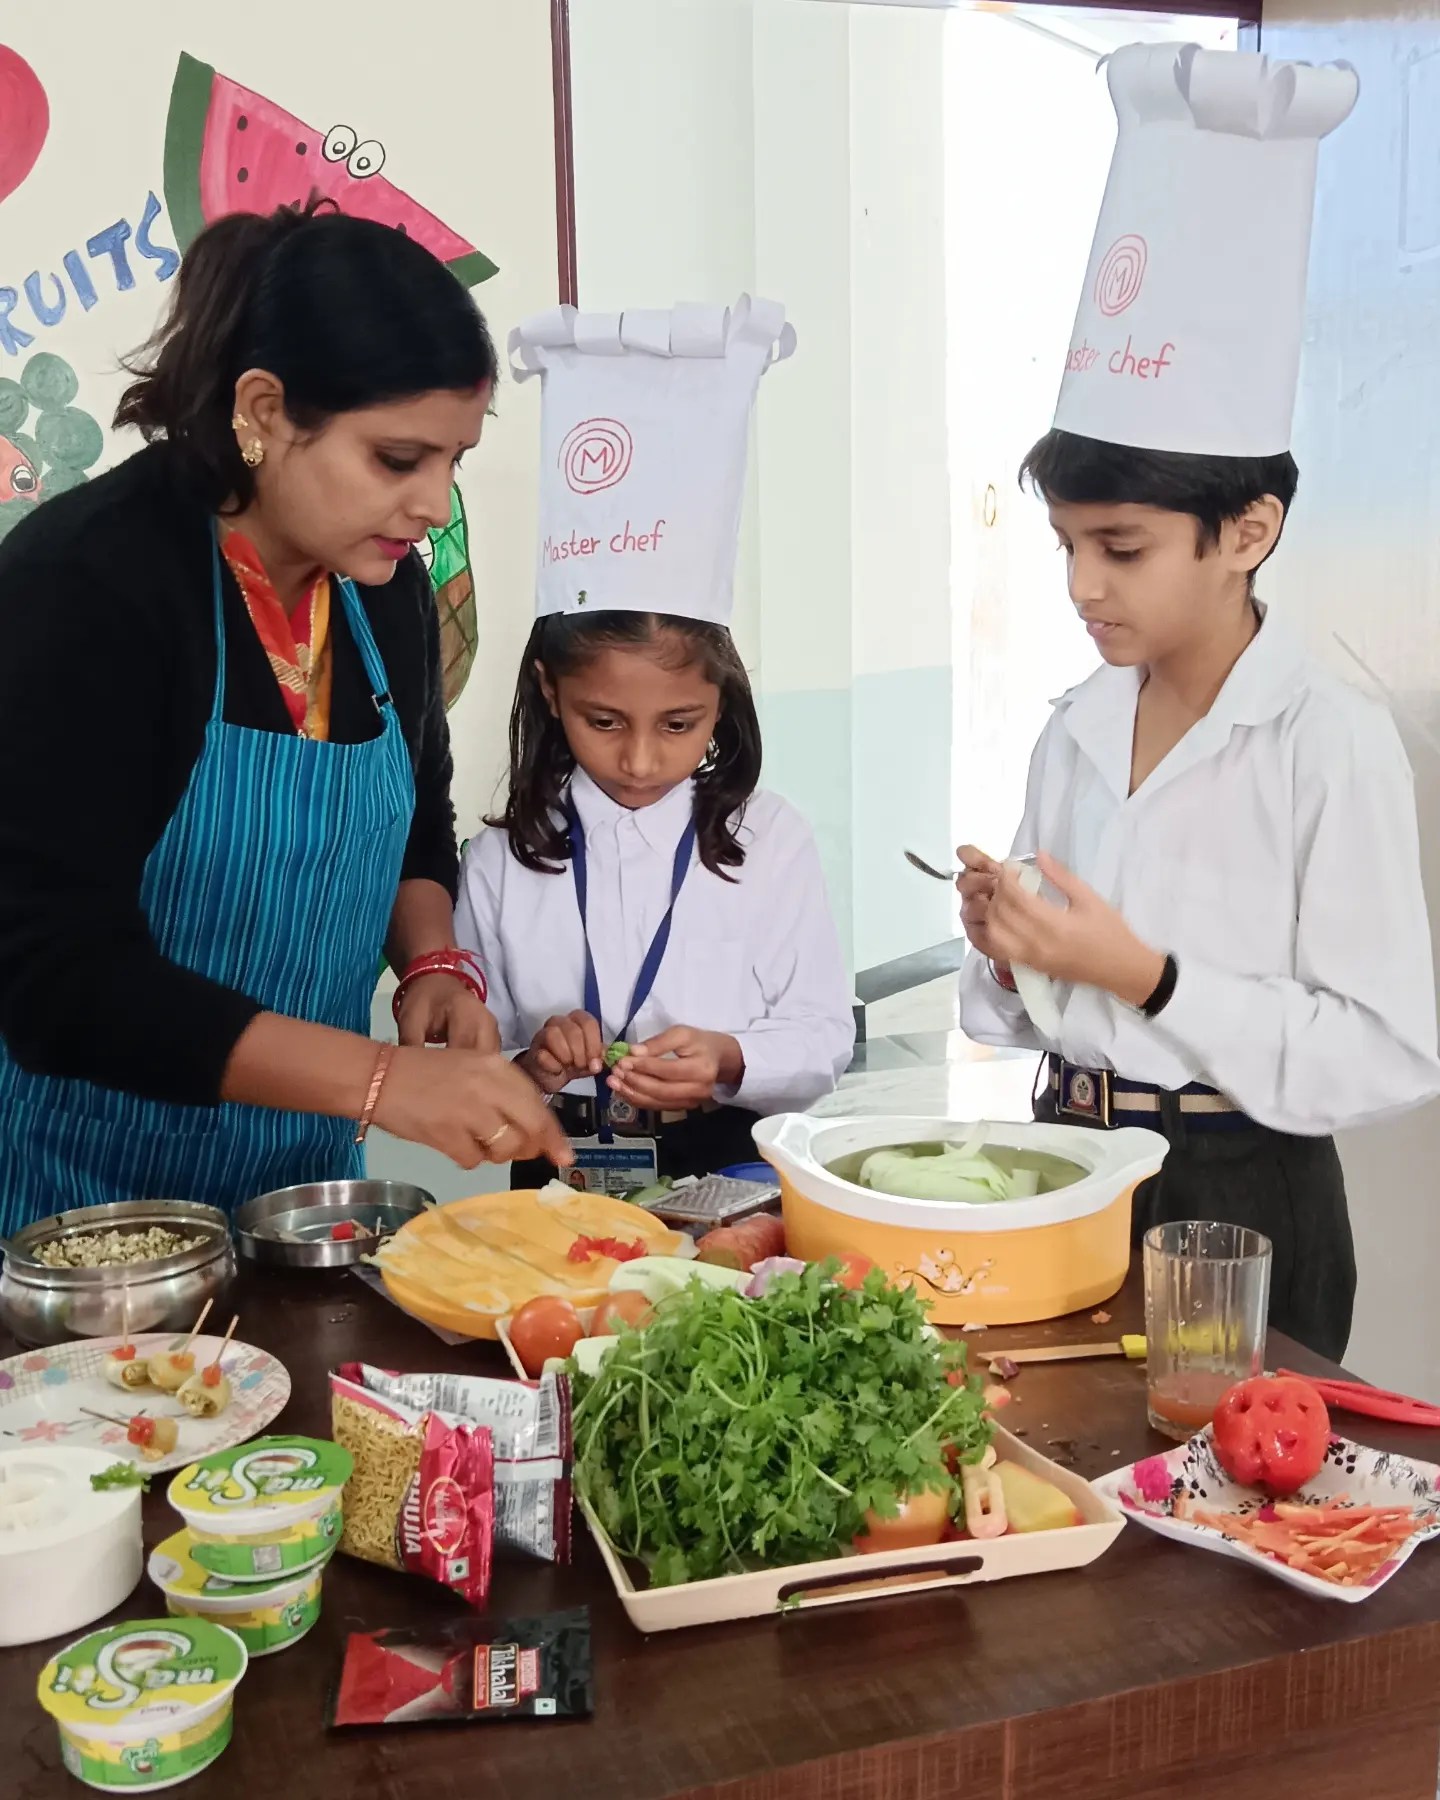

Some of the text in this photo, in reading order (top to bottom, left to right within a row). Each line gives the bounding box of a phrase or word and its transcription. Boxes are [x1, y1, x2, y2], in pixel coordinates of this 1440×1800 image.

[0, 190, 180, 356] RUITS
[1065, 334, 1176, 379] aster chef
[542, 519, 666, 568] Master chef
[490, 1645, 516, 1705] Tikhalal
